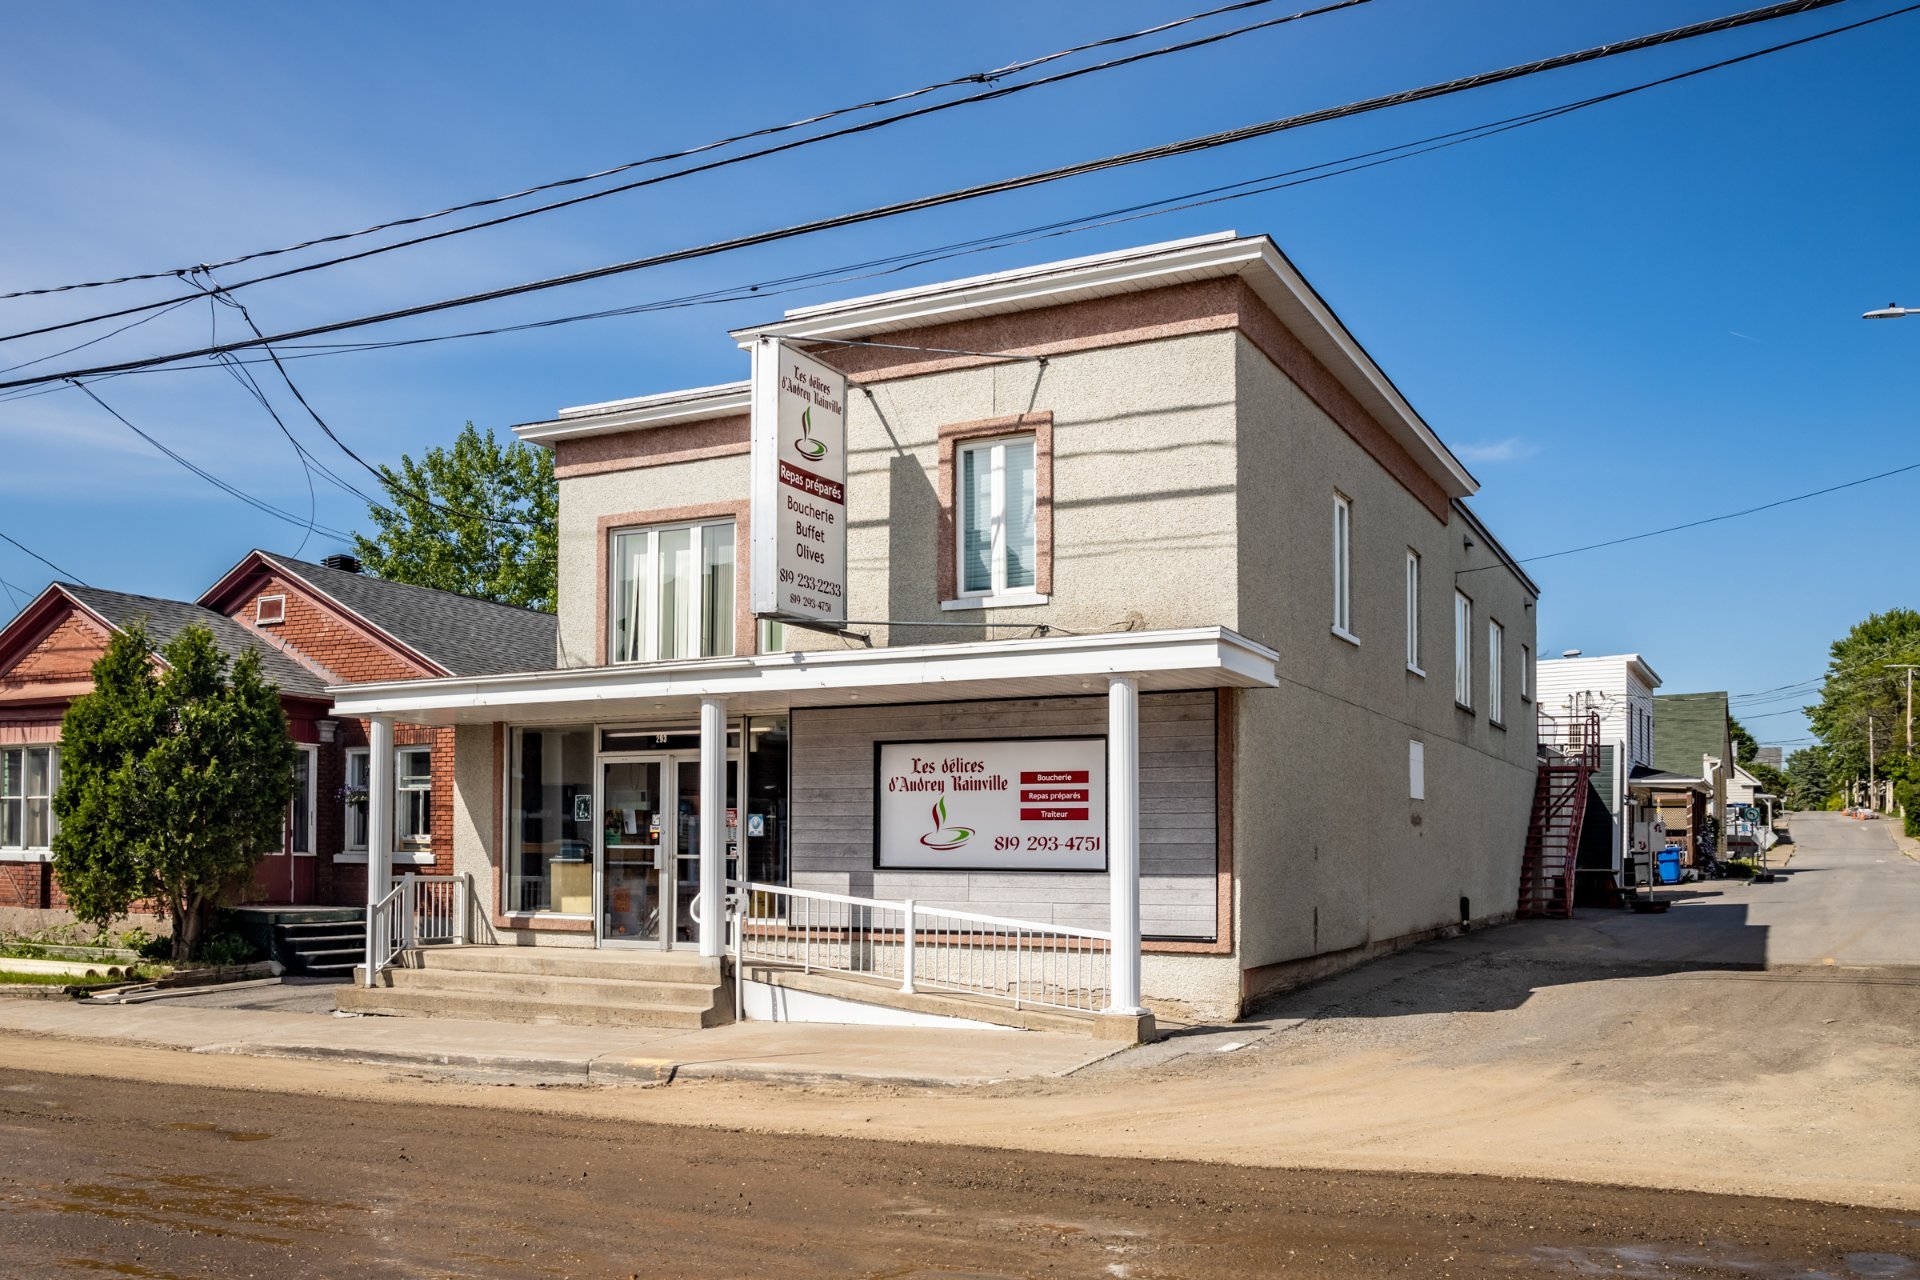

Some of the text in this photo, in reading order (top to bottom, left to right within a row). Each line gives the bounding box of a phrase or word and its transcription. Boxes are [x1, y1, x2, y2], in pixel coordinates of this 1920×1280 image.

[794, 365, 831, 395] Les délices
[782, 376, 842, 415] d'Audrey Rainville
[780, 465, 842, 499] Repas préparés
[787, 495, 834, 524] Boucherie
[796, 521, 825, 543] Buffet
[796, 543, 825, 564] Olives
[779, 568, 841, 597] 819 233-2233
[790, 593, 832, 612] 819 293-4751
[911, 757, 985, 774] Les délices
[888, 774, 1008, 795] d'Audrey Rainville
[1028, 792, 1081, 801] Repas préparés
[1040, 810, 1069, 818] Traiteur
[994, 836, 1101, 851] 819 293-4751
